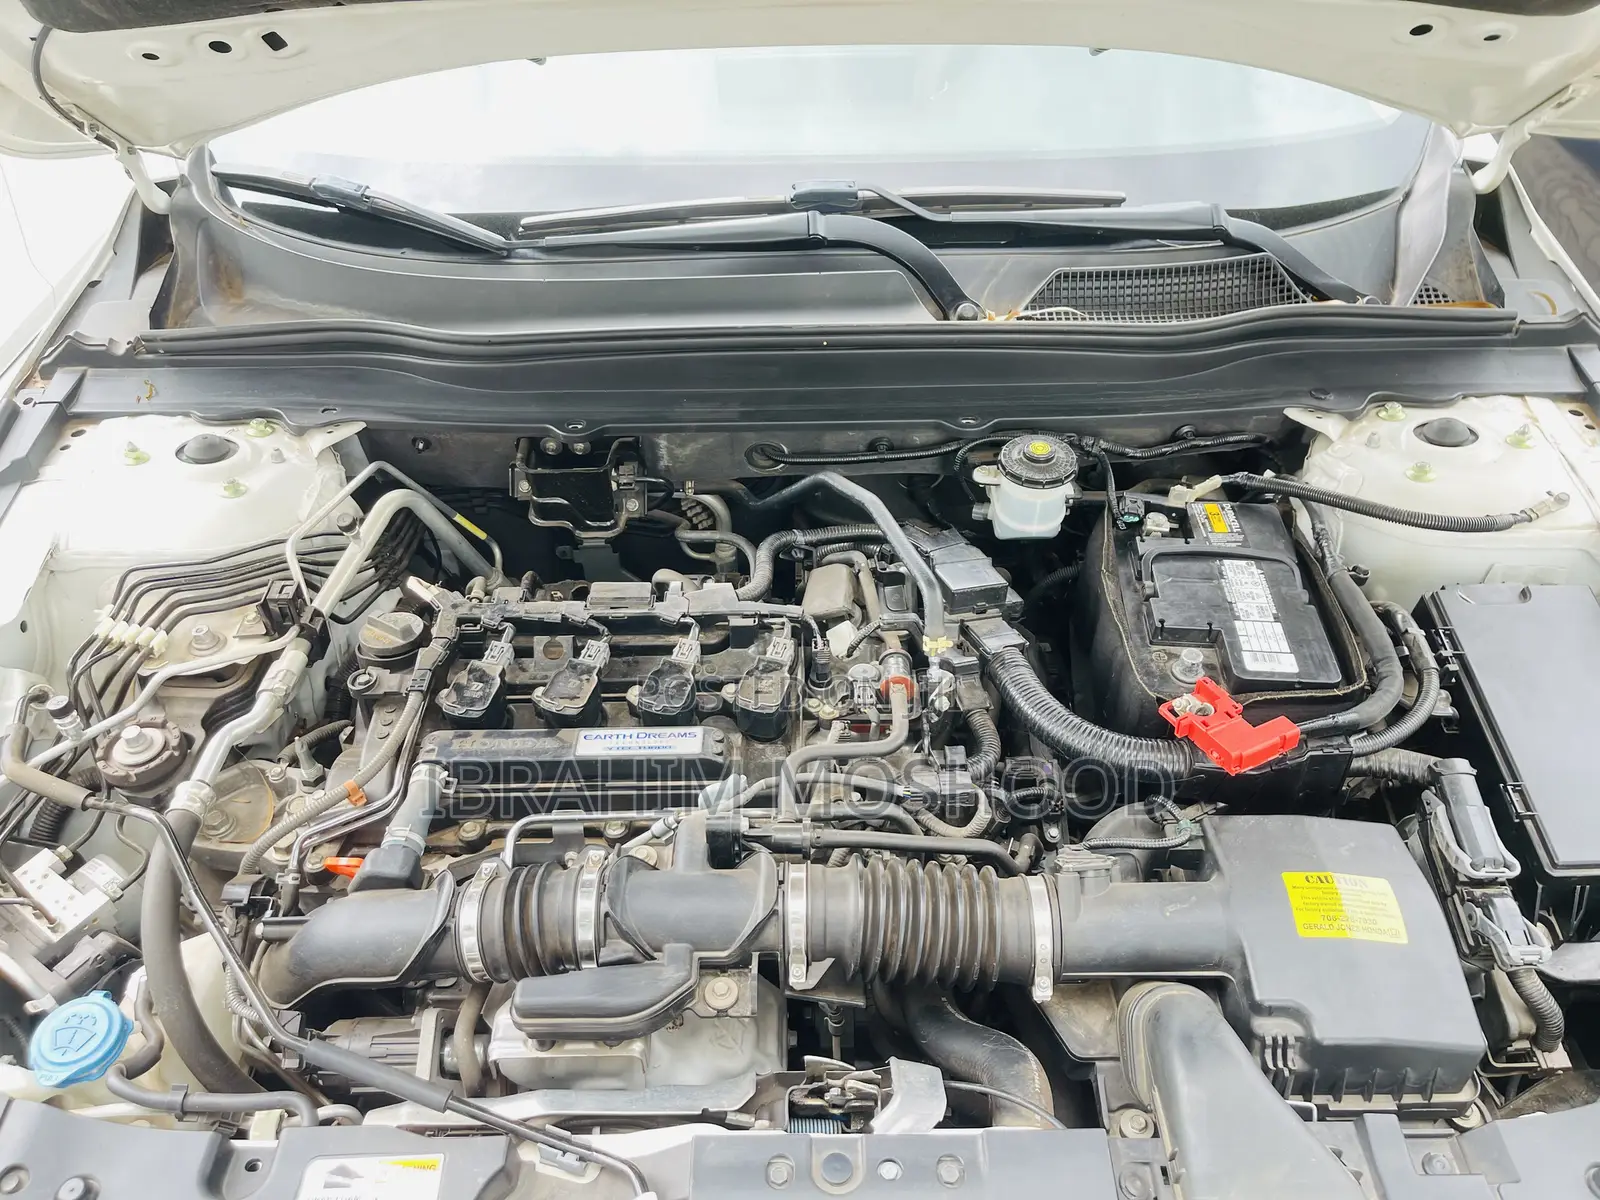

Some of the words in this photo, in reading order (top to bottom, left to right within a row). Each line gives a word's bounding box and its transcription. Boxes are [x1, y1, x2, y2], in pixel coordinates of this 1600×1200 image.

[1223, 503, 1242, 533] DURACELL
[583, 733, 633, 741] EARTH
[636, 731, 698, 740] DREAMS
[1304, 874, 1369, 889] CAUTION
[1303, 922, 1335, 931] GERALD
[1336, 924, 1361, 933] JONES
